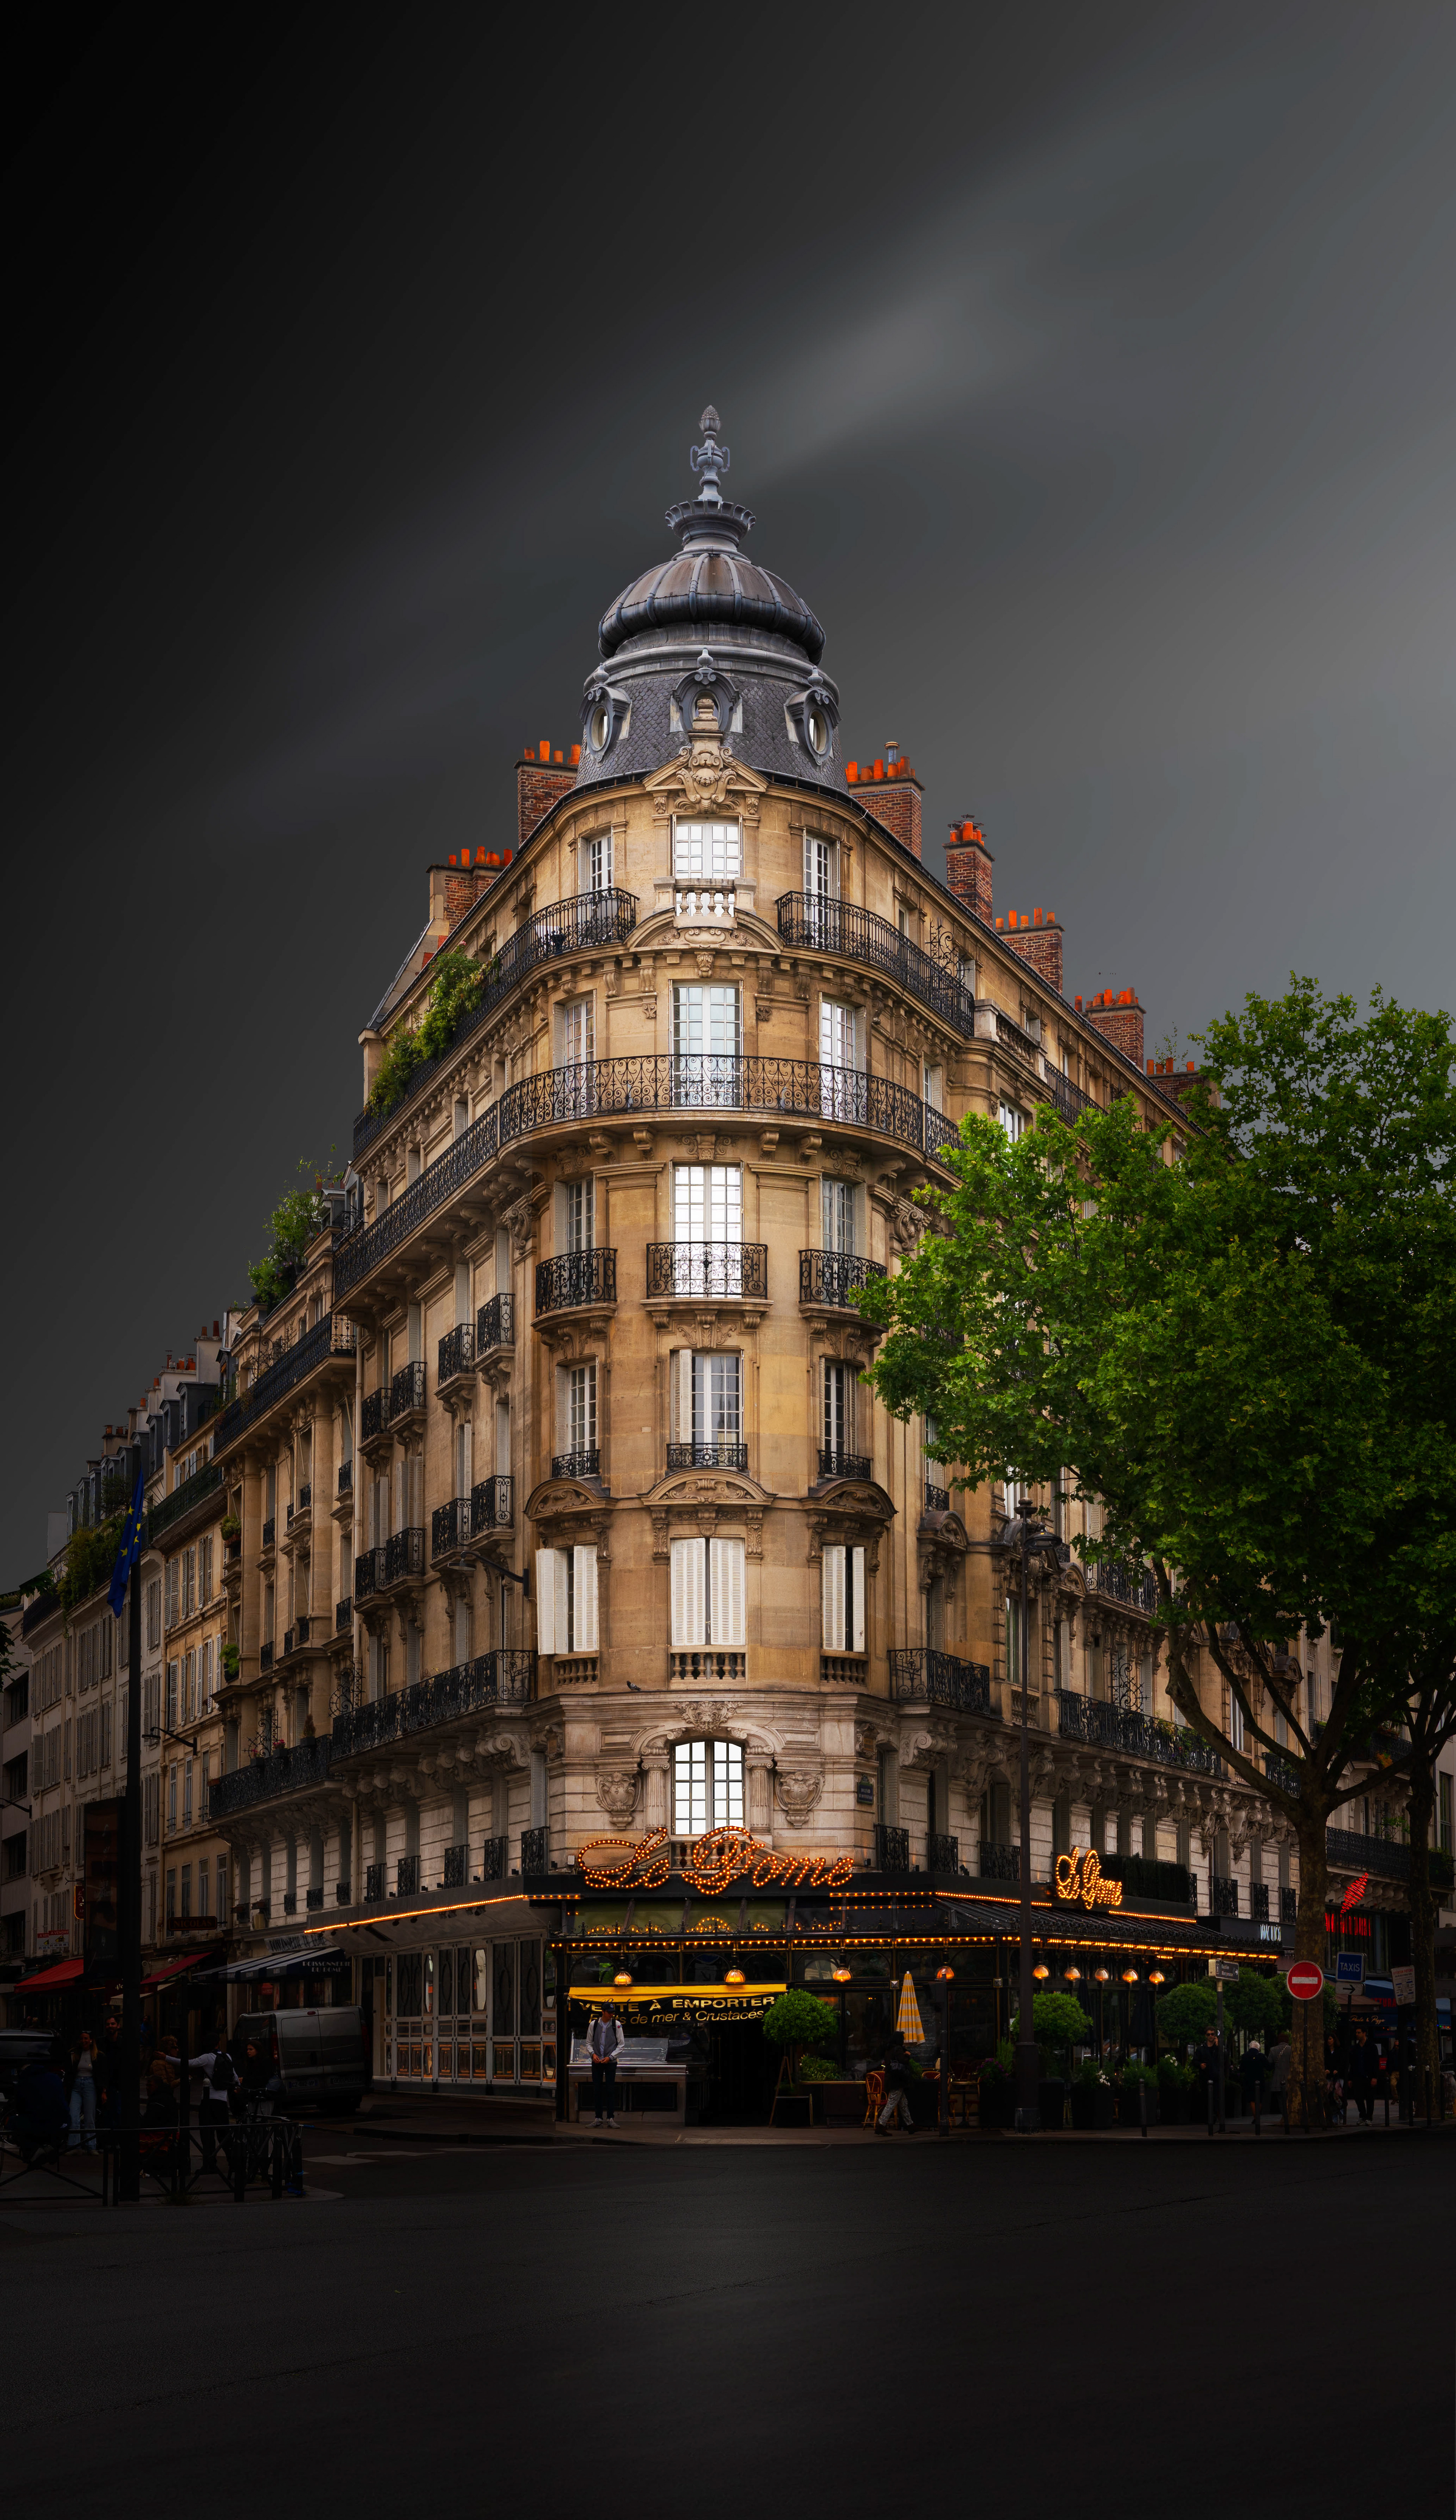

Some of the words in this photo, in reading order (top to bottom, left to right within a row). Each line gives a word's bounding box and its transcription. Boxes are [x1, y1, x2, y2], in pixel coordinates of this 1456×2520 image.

[578, 1827, 669, 1889] Le
[1055, 1846, 1080, 1899] Le
[173, 1919, 212, 1928] NICOLAS
[1340, 1962, 1360, 1972] TAXIS
[579, 2002, 639, 2012] VETE
[649, 2000, 662, 2010] À
[672, 1996, 775, 2008] EMPORTER
[630, 2014, 648, 2024] de
[651, 2013, 680, 2023] mer
[682, 2012, 691, 2021] &
[695, 2009, 764, 2021] Crustacés
